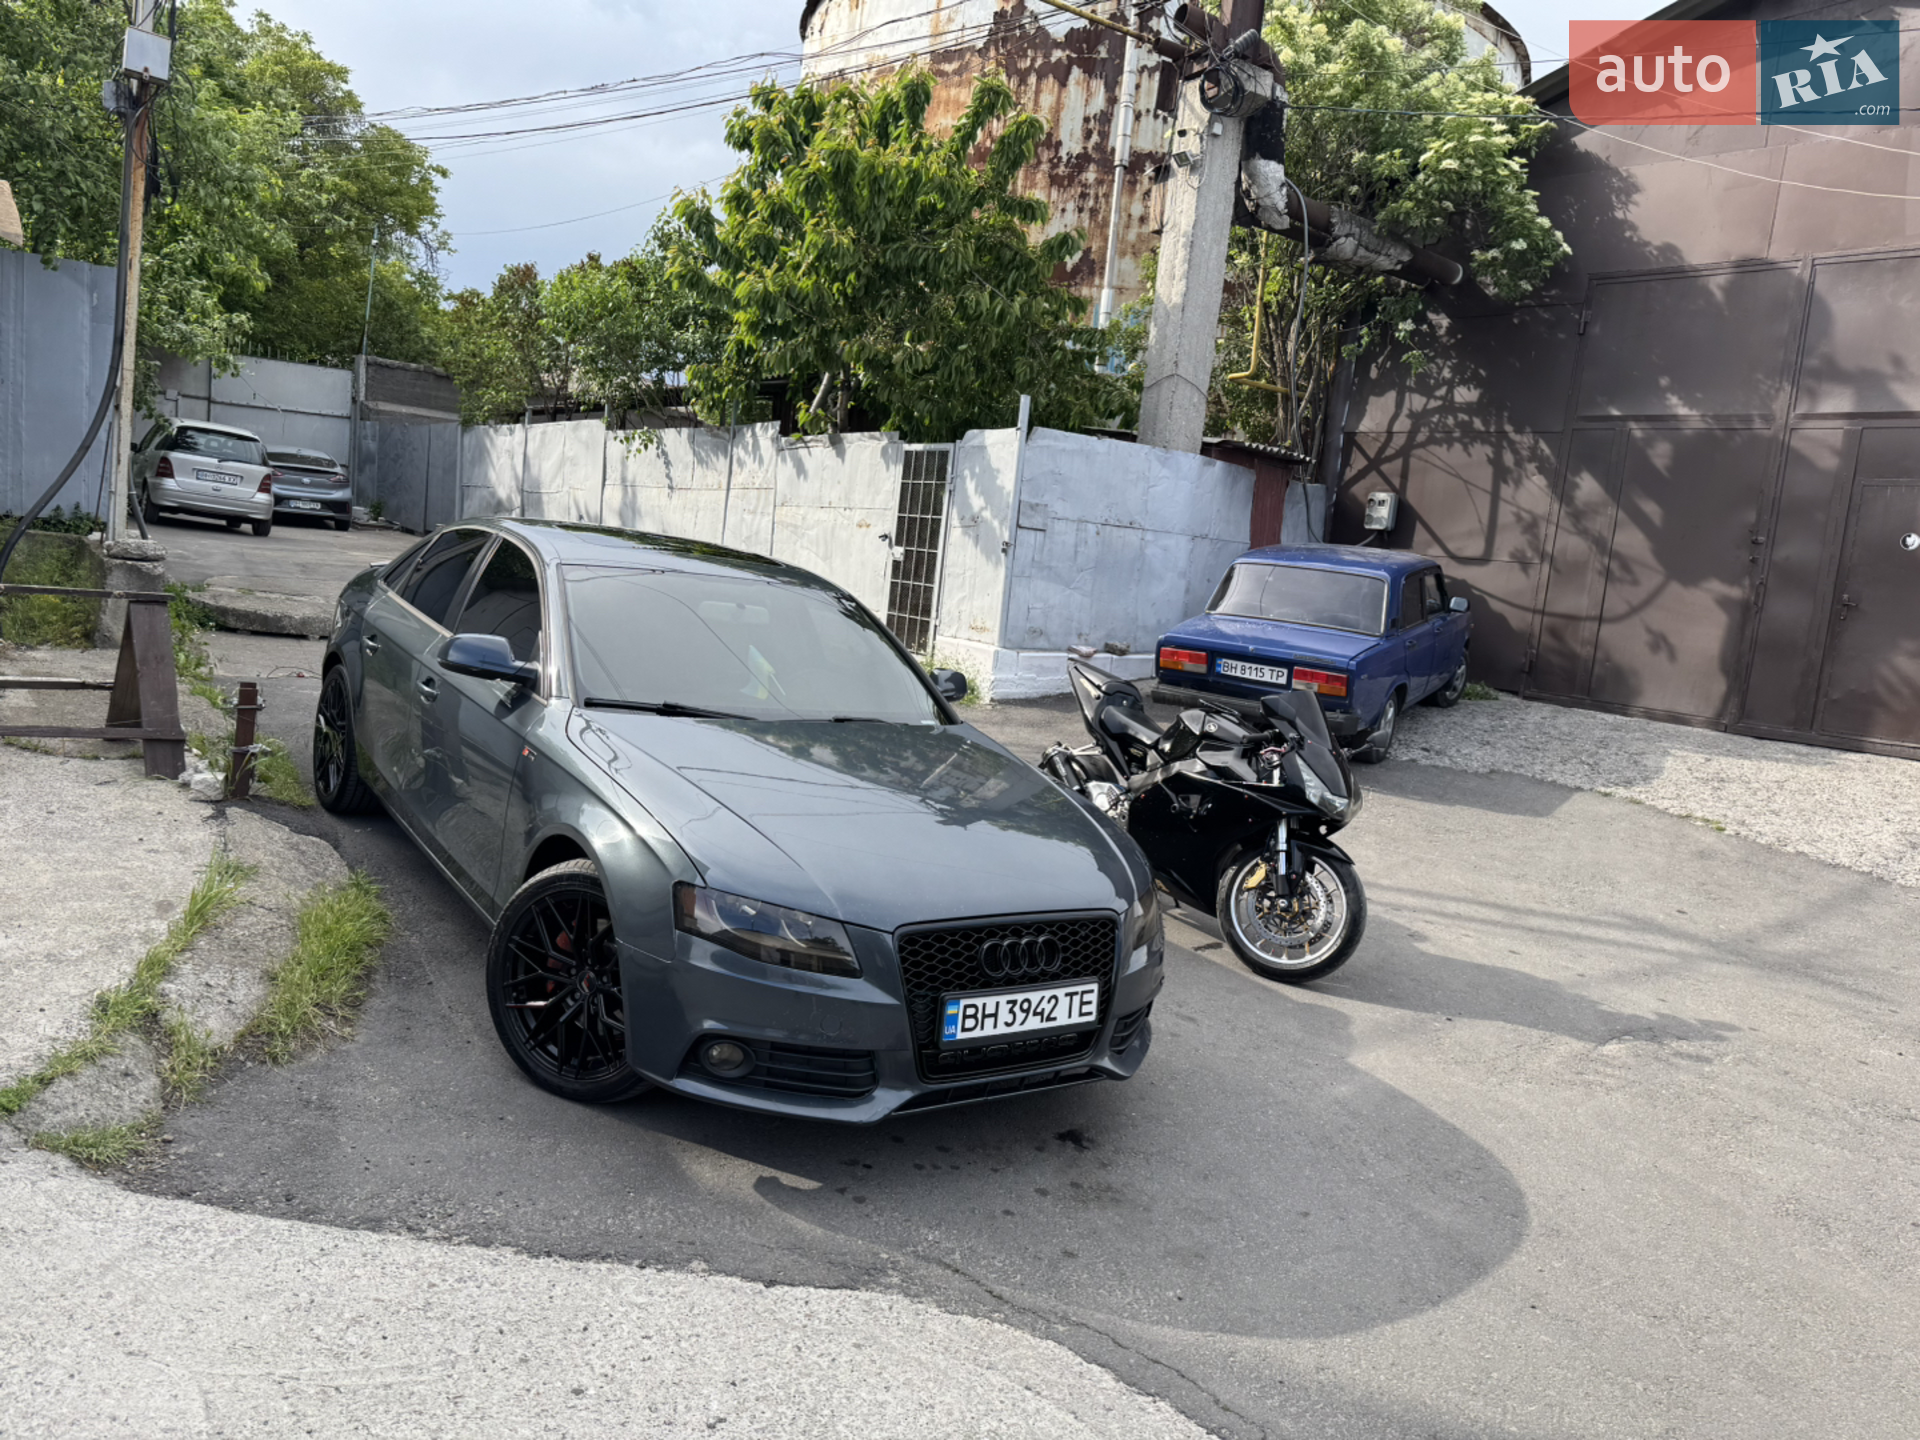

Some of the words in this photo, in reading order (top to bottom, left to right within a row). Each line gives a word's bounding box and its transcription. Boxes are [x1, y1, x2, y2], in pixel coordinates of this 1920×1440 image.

[1222, 661, 1238, 674] BH
[1239, 664, 1265, 678] 8115
[1268, 668, 1285, 681] TP
[960, 1001, 1000, 1033] BH
[1003, 994, 1059, 1028] 3942
[1064, 989, 1095, 1019] TE
[944, 1024, 957, 1035] UA
